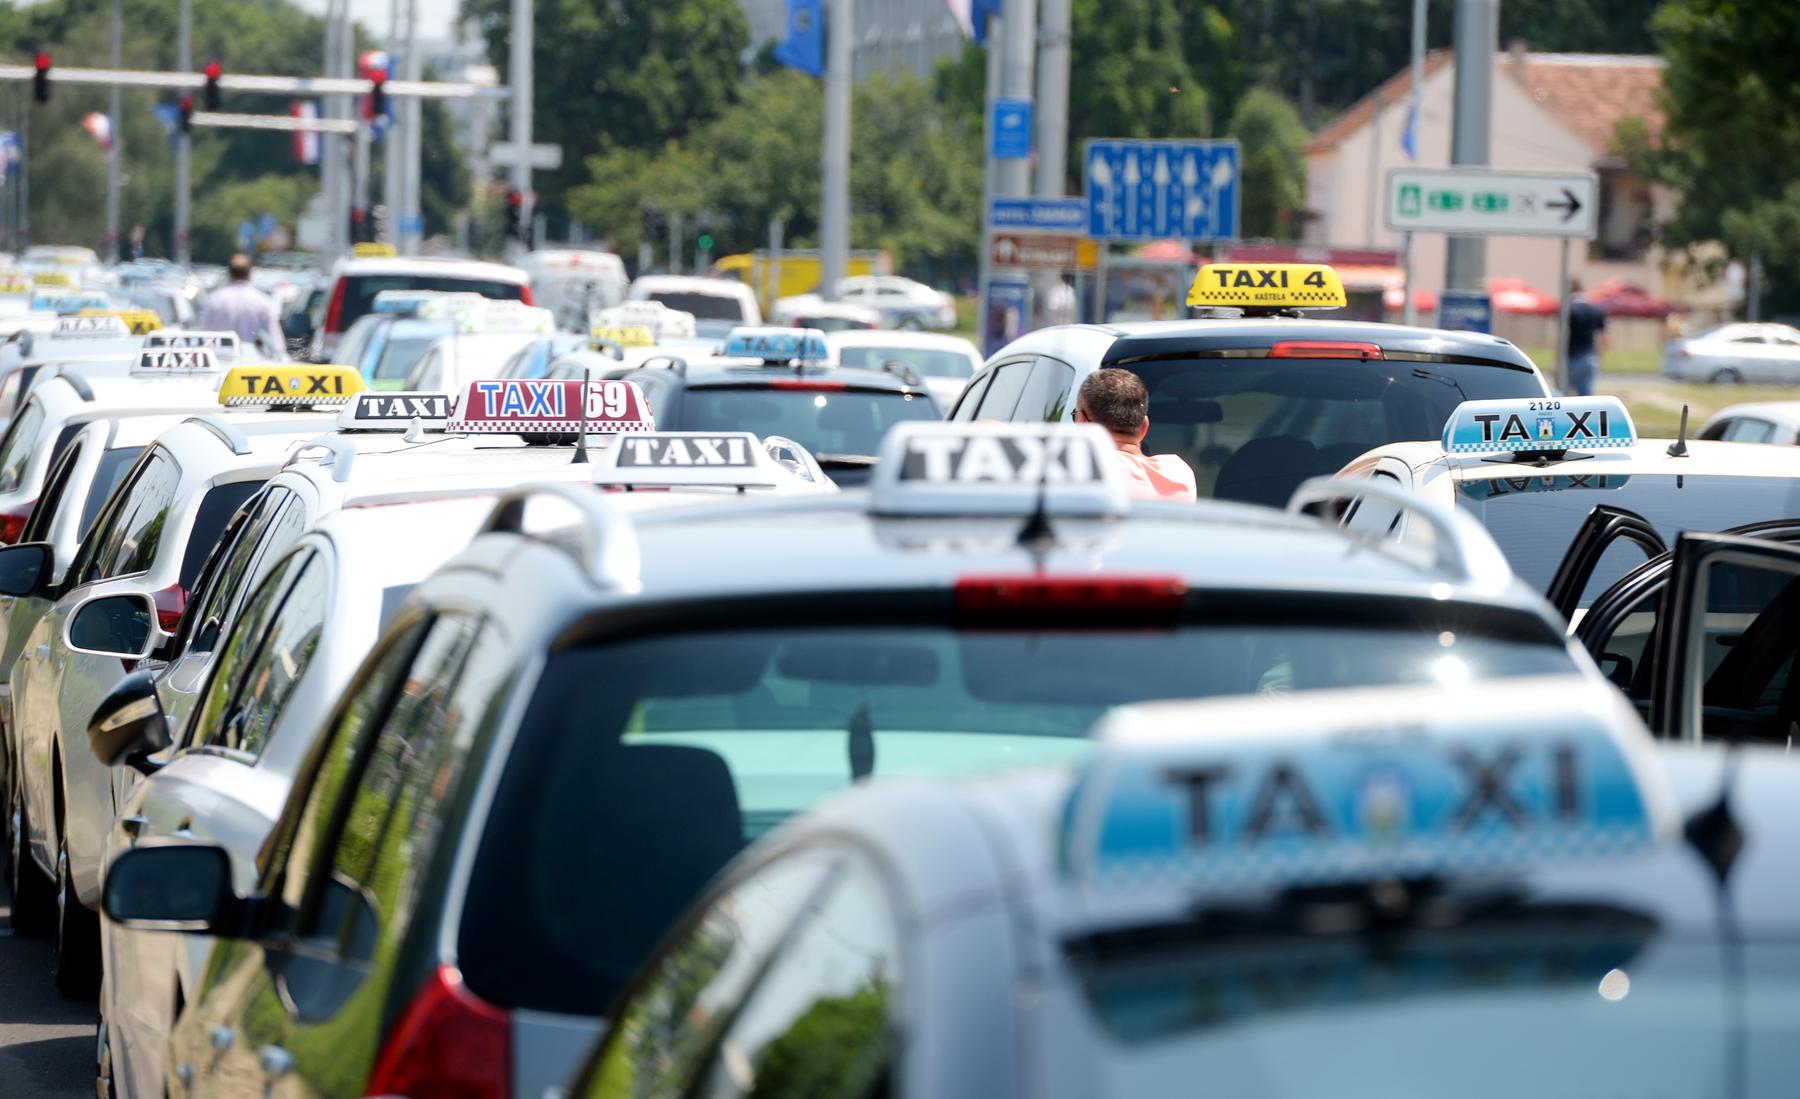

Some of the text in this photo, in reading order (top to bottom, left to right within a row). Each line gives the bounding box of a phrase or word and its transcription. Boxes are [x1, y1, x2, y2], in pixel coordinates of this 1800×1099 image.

[1212, 270, 1326, 288] TAXI 4
[1254, 291, 1286, 301] KAŠTELA
[362, 397, 447, 417] TAXI
[477, 381, 566, 418] TAXI
[579, 382, 627, 418] 69
[1529, 401, 1561, 411] 2120
[626, 438, 747, 465] TAXI
[909, 436, 1092, 482] TAXI
